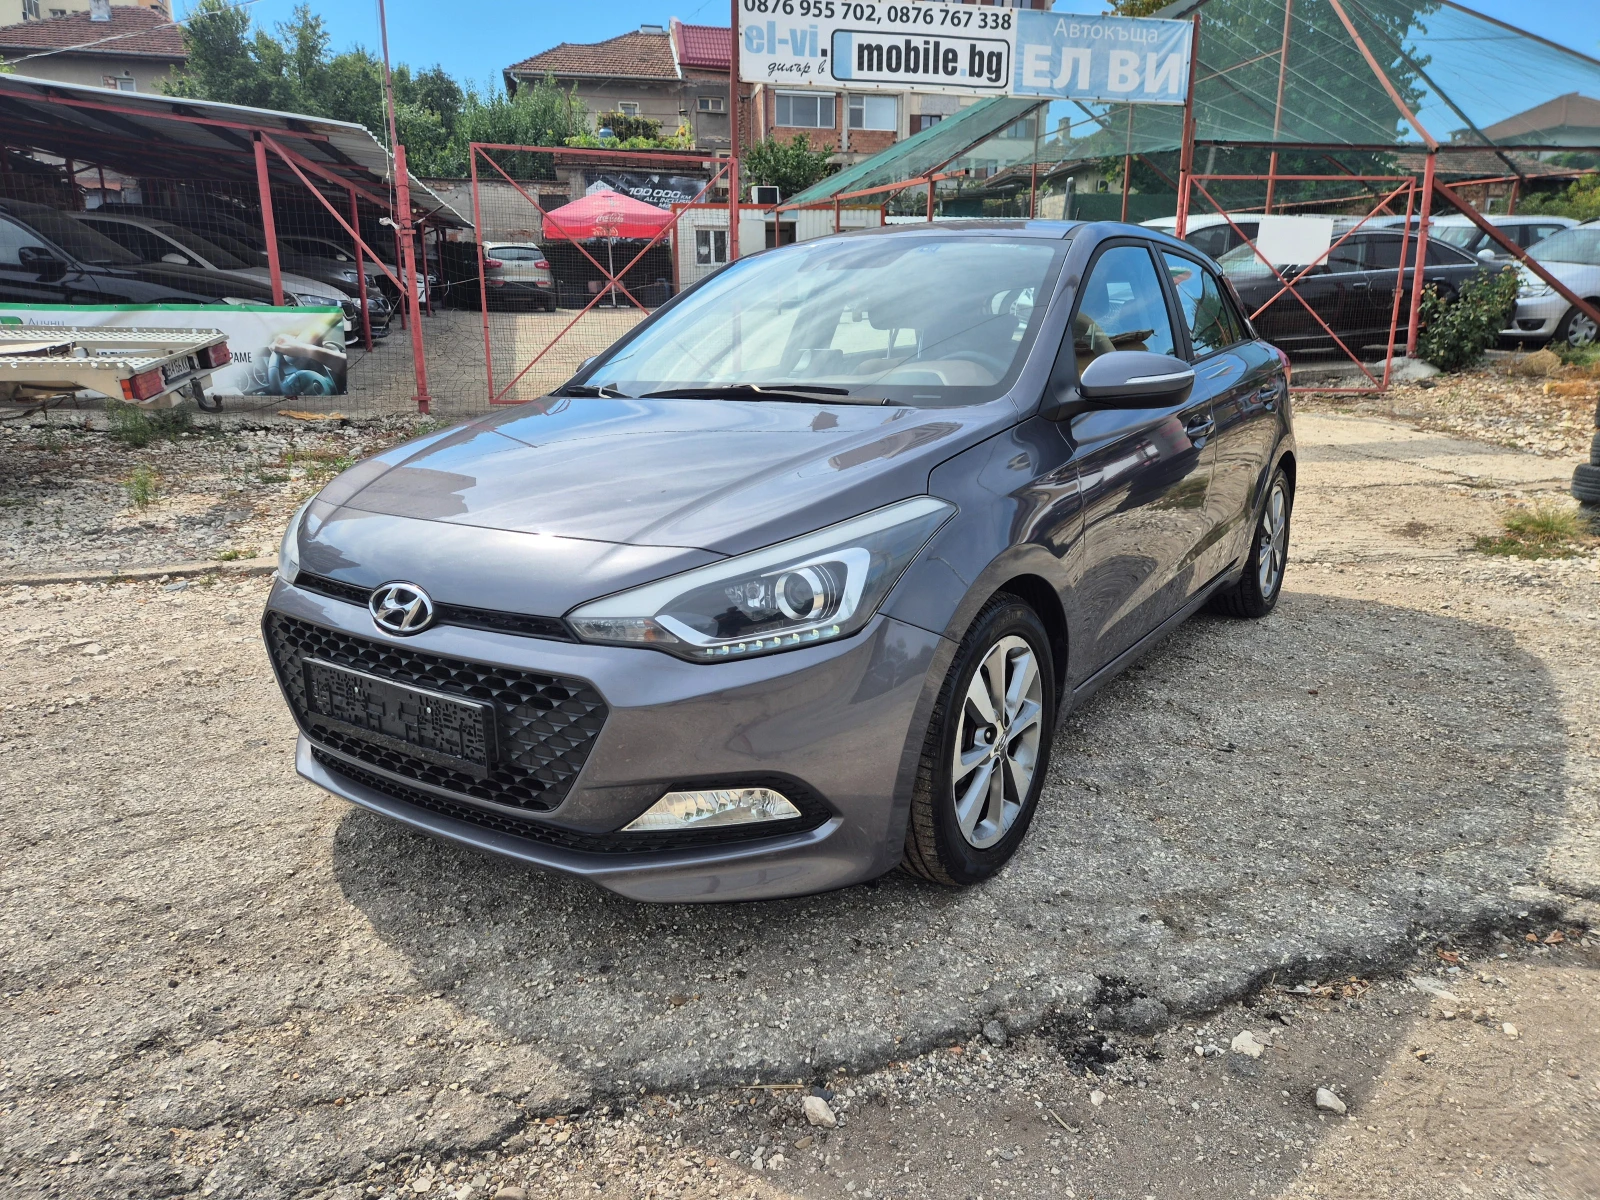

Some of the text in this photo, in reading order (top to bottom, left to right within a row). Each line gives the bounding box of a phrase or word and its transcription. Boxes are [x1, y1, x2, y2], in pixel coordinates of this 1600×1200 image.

[744, 0, 1012, 30] 0876 955 702, 0876 767 338
[1053, 18, 1159, 46] Автокъща
[767, 59, 827, 77] дилър в
[857, 38, 1003, 82] mobile.bg
[1022, 43, 1181, 94] ЕЛ ВИ
[628, 187, 653, 196] 100
[653, 189, 682, 199] 000
